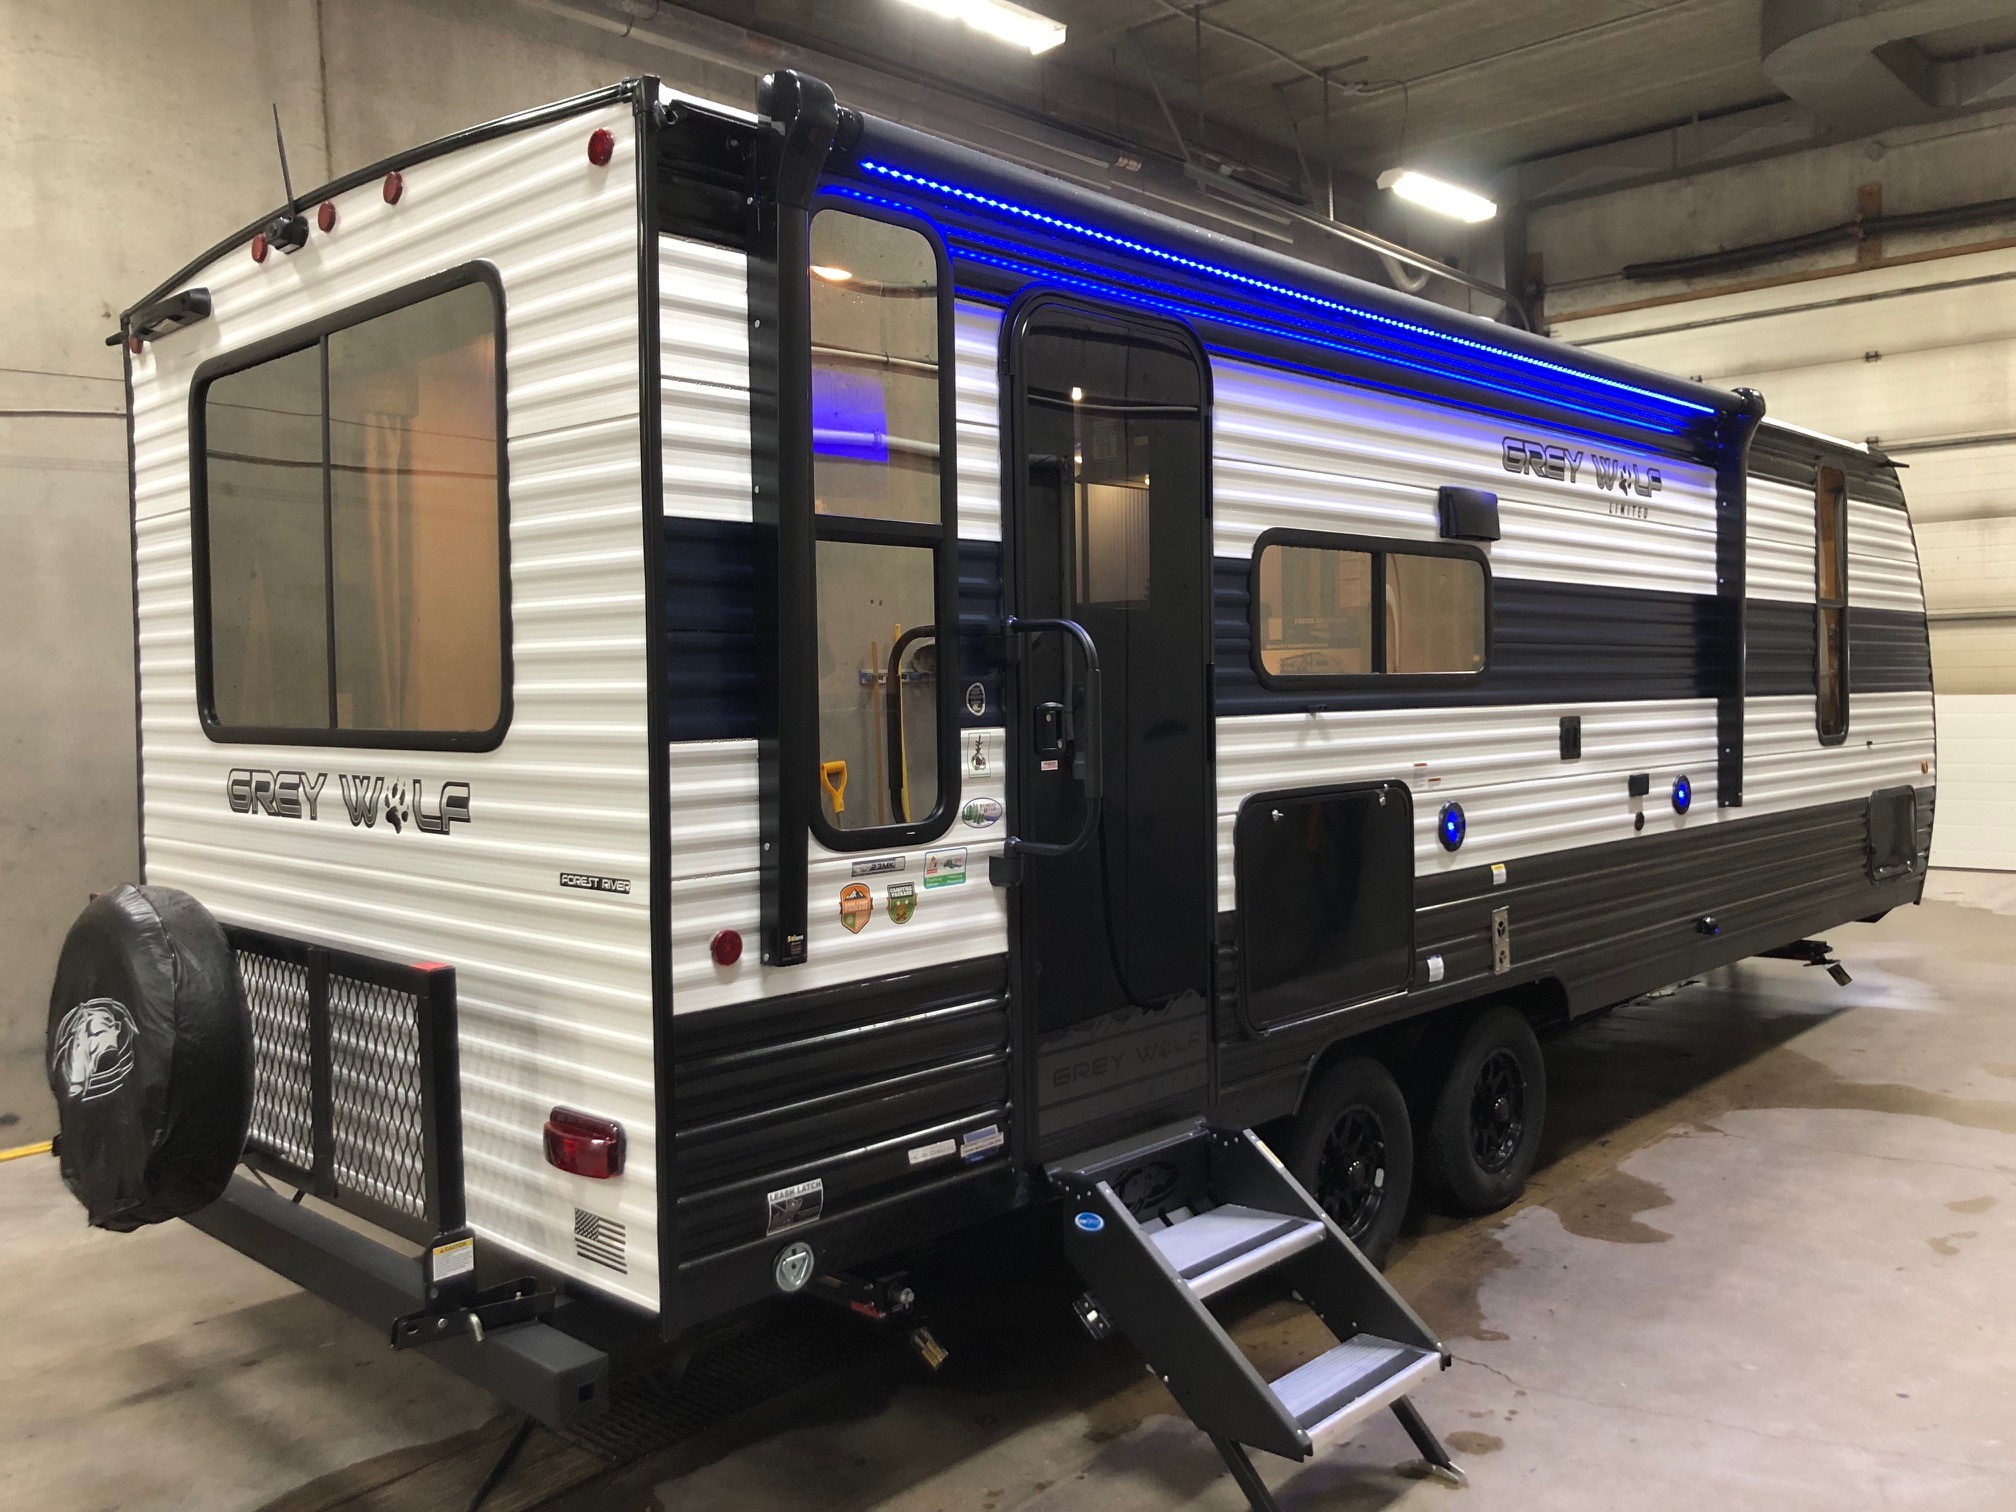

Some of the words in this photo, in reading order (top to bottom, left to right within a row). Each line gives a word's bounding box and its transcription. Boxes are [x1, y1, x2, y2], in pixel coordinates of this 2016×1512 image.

[1502, 435, 1584, 484] GREY
[1609, 501, 1648, 519] LIMITED
[227, 767, 328, 821] GREY
[561, 874, 599, 888] FOREST
[601, 878, 631, 892] RIVER
[1053, 1050, 1125, 1088] GREY
[770, 1189, 795, 1202] LEASH
[797, 1180, 822, 1194] LATCH
